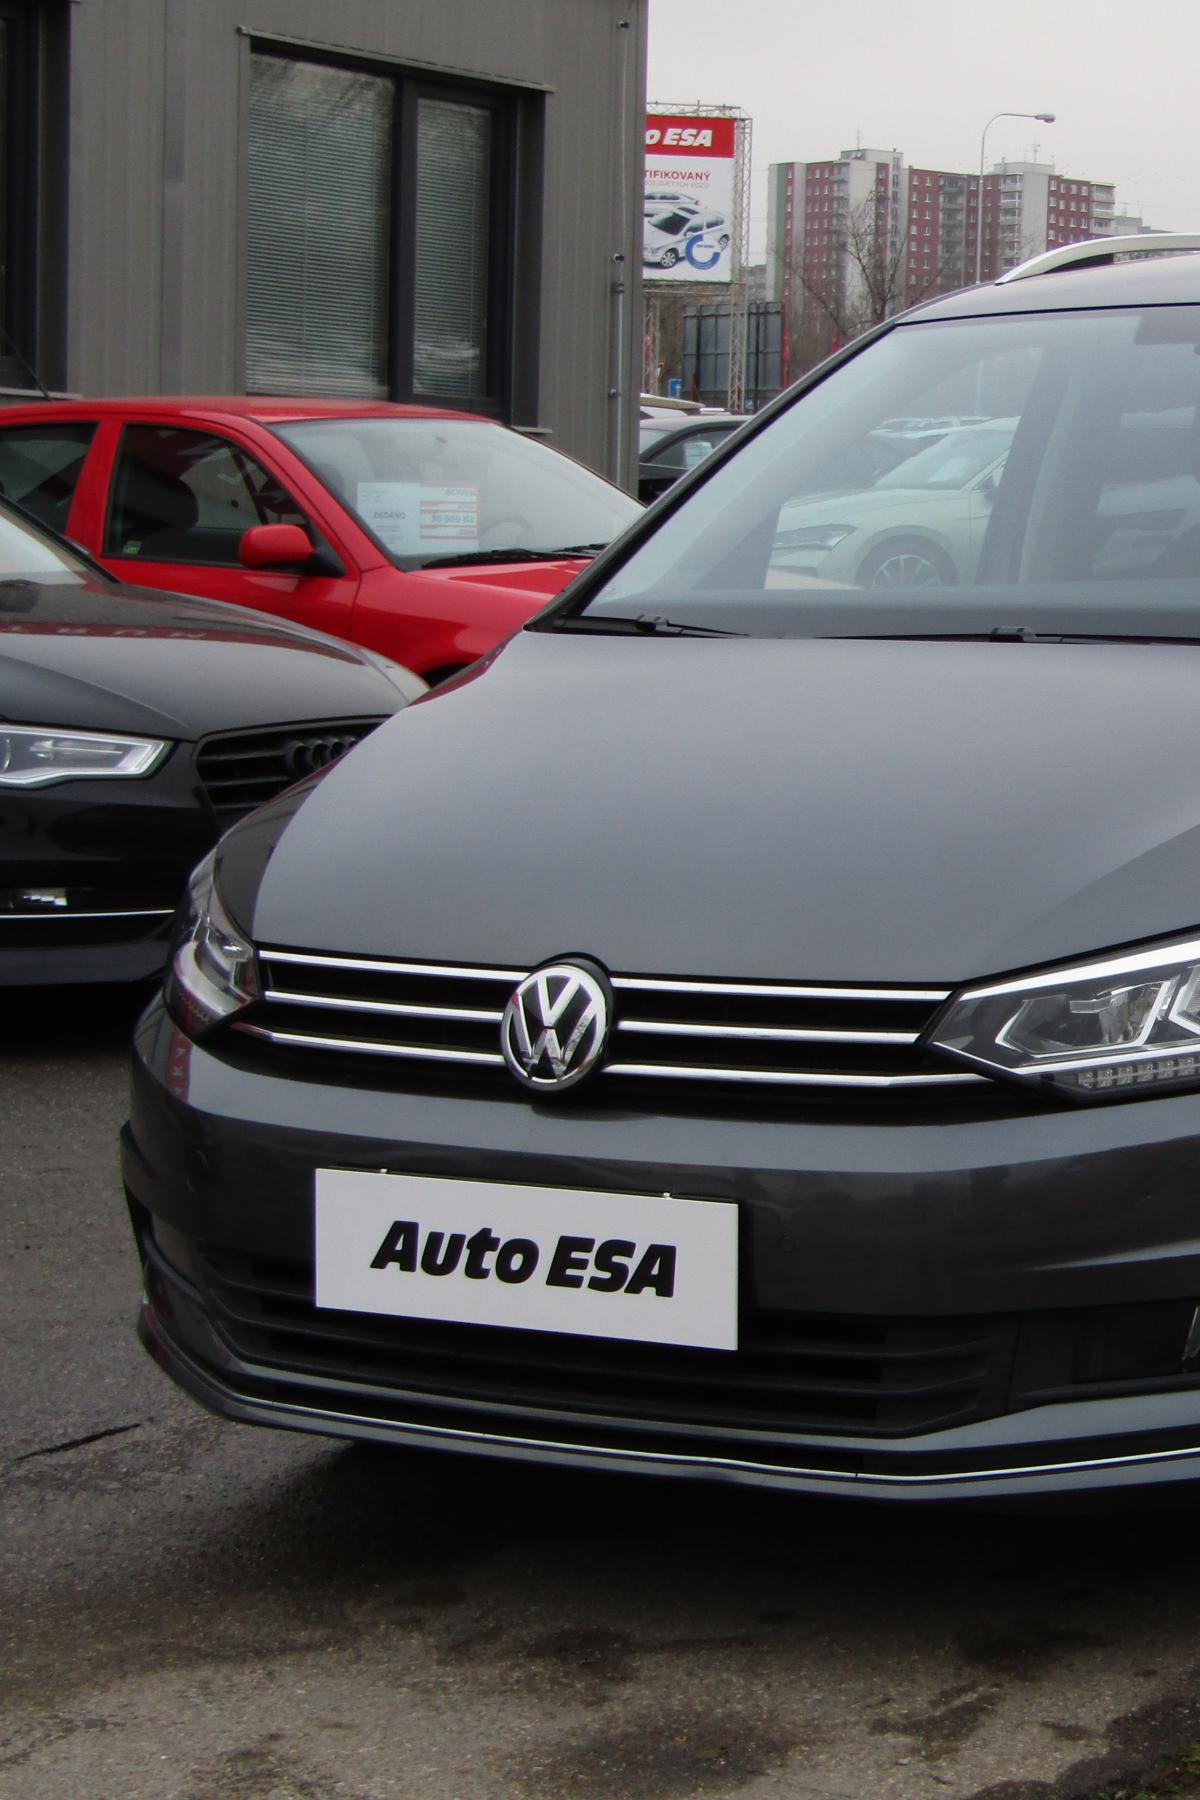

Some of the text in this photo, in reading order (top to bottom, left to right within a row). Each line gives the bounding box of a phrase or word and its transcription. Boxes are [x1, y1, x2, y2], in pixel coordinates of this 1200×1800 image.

[662, 128, 713, 147] ESA
[370, 1220, 677, 1298] Auto ESA
